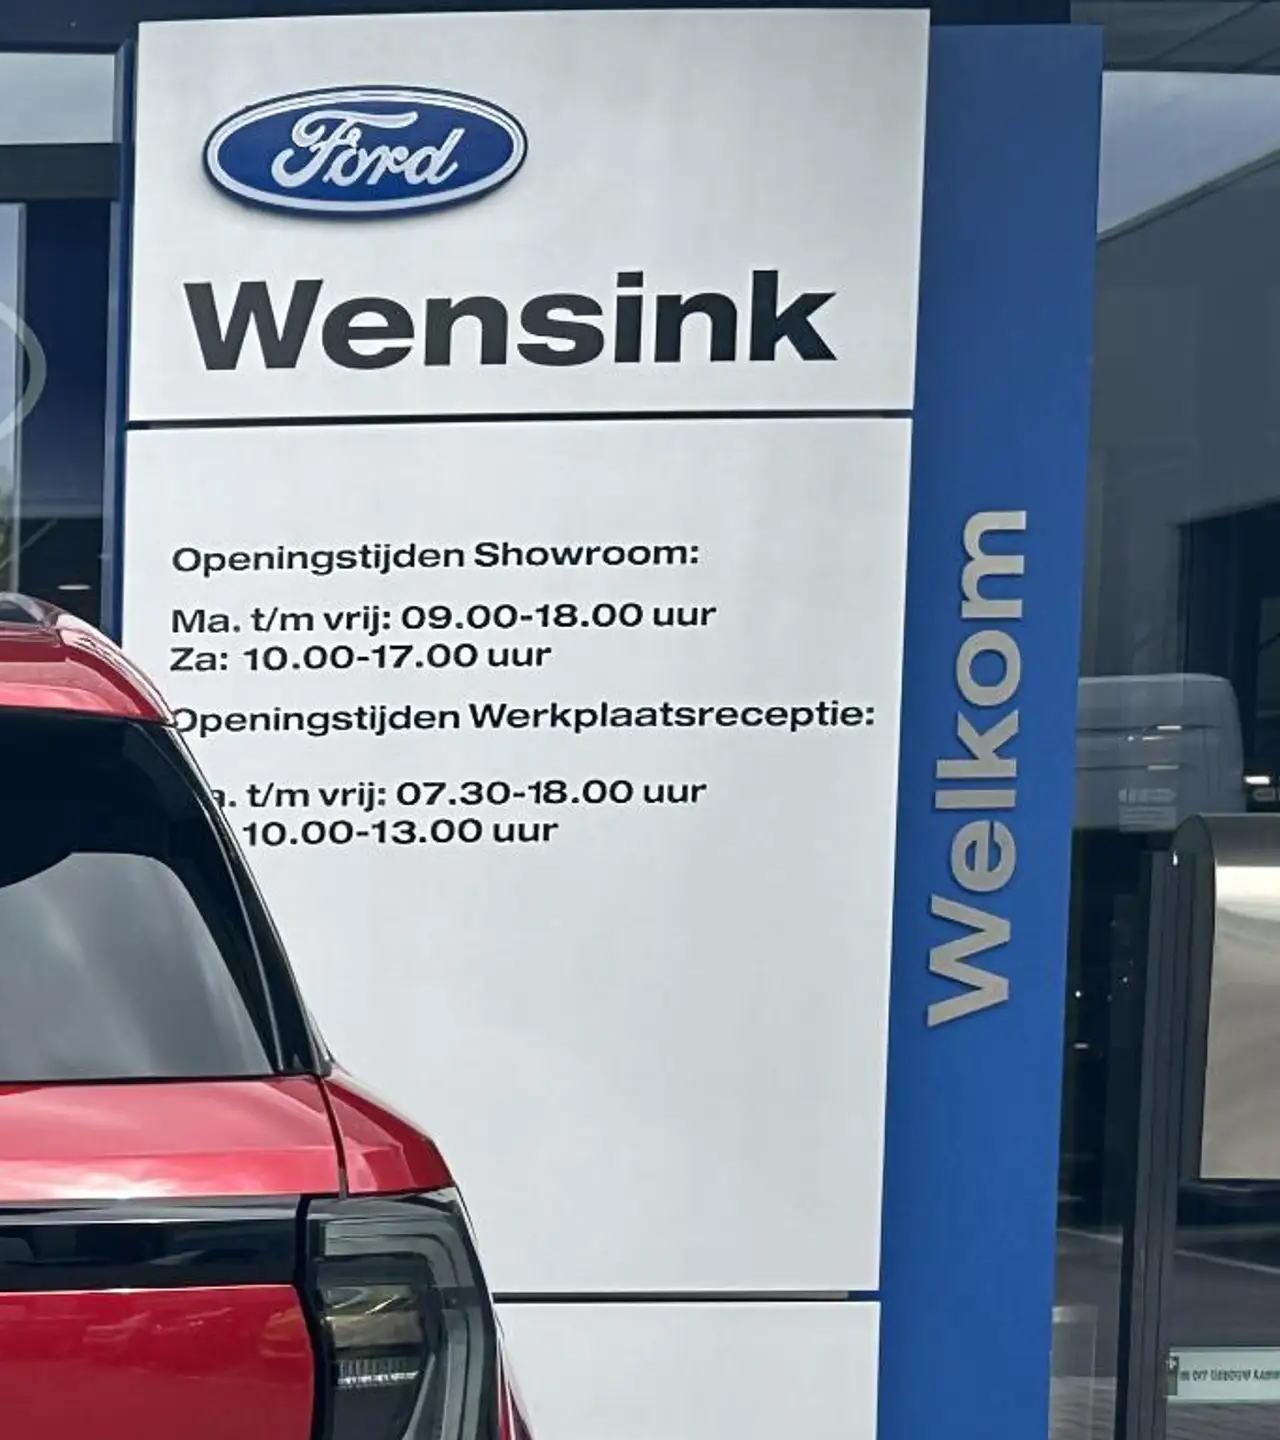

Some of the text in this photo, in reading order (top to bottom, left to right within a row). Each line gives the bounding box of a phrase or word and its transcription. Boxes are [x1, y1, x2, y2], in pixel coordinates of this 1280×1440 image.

[271, 109, 466, 188] Ford
[183, 269, 839, 371] Wensink
[172, 541, 700, 578] Openingstijden Showroom:
[172, 602, 717, 637] Ma. t/m vrij: 09.00-18.00 uur
[169, 643, 552, 672] Za: 10.00-17.00 uur
[175, 699, 876, 739] Openingstijden Werkplaatsreceptie:
[926, 510, 1027, 1028] Welkom
[246, 782, 311, 809] t/m
[318, 781, 387, 813] vrij:
[396, 779, 634, 806] 07.30-18.00
[643, 782, 708, 805] uur
[242, 817, 560, 847] 10.00-13.00 uur
